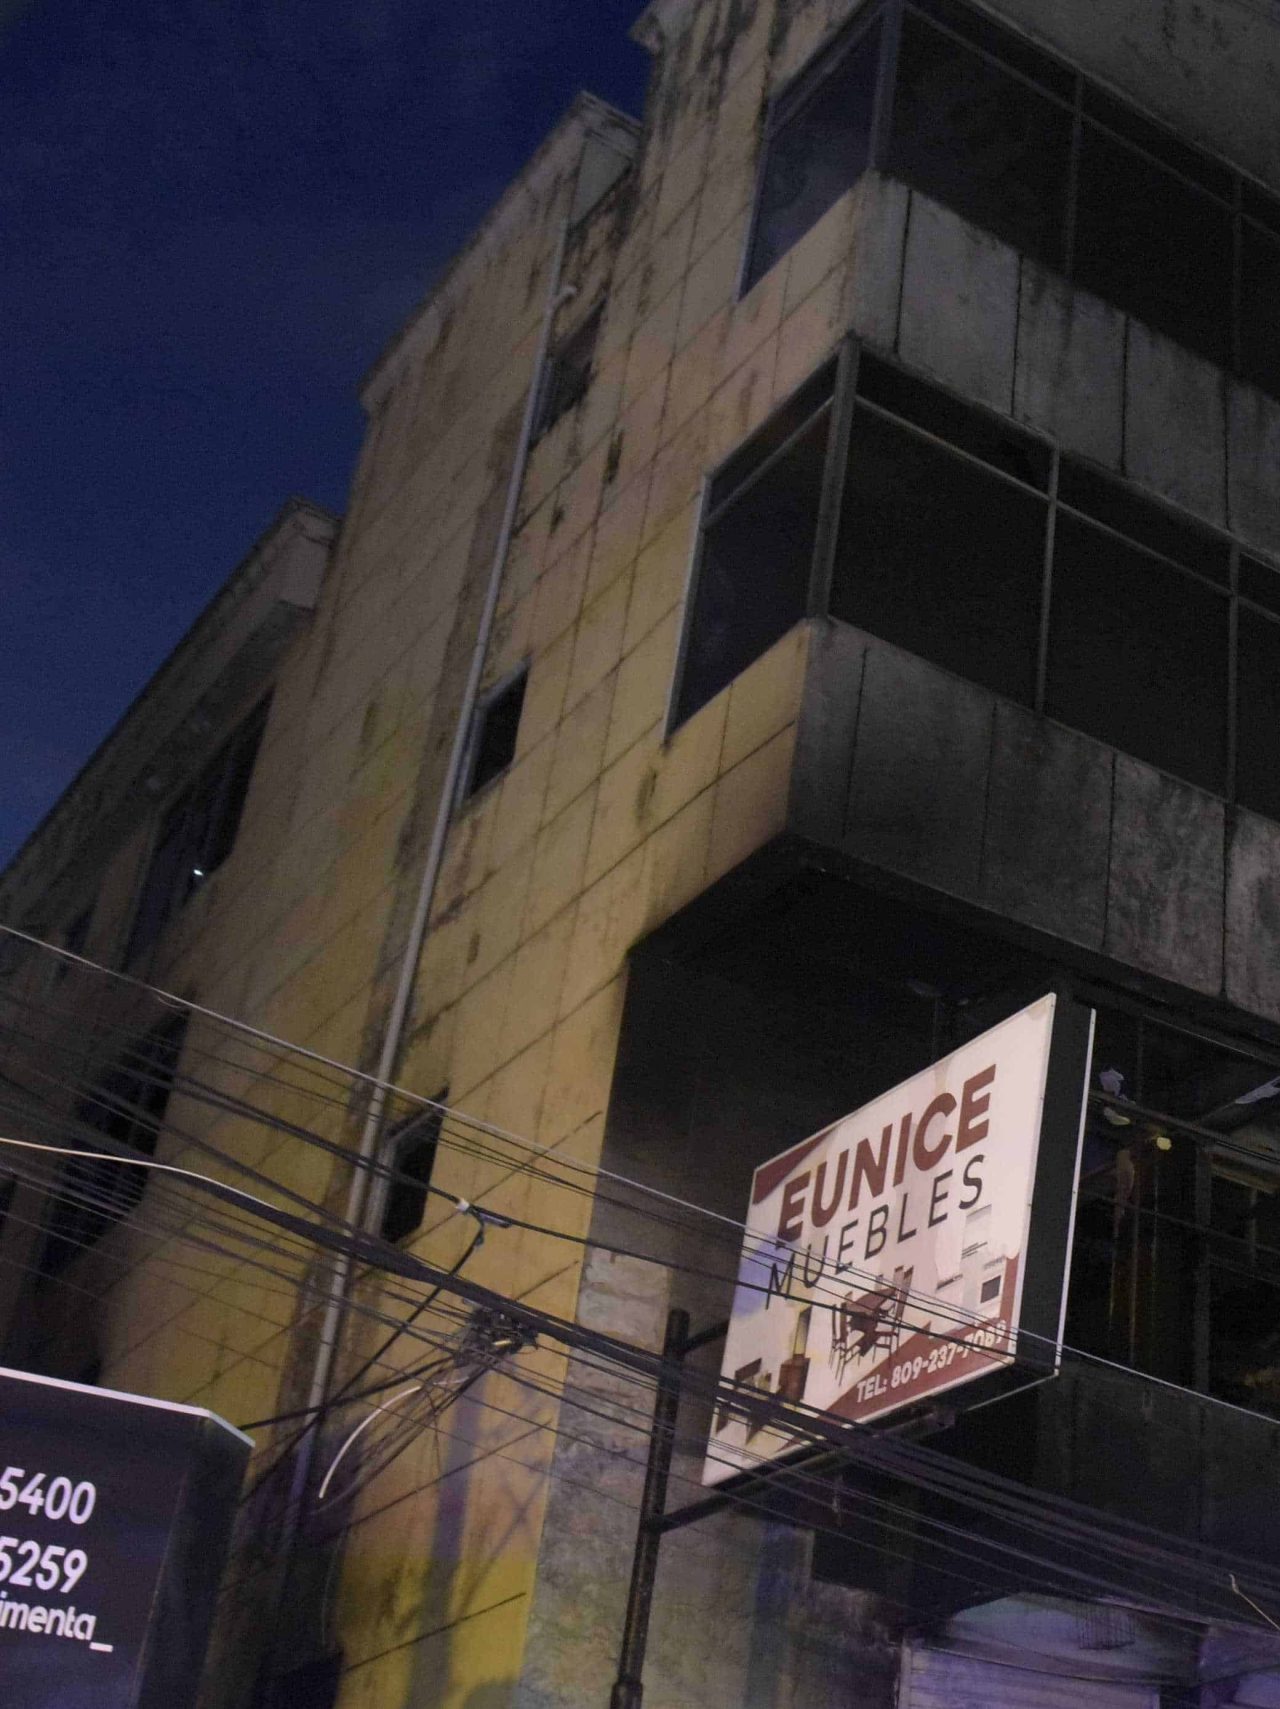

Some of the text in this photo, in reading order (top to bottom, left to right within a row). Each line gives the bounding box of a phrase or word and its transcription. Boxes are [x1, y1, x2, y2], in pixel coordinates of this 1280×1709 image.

[776, 1064, 996, 1249] EUNICE
[766, 1155, 984, 1310] MUEBLES
[857, 1373, 887, 1403] TEL:
[0, 1466, 97, 1525] 5400
